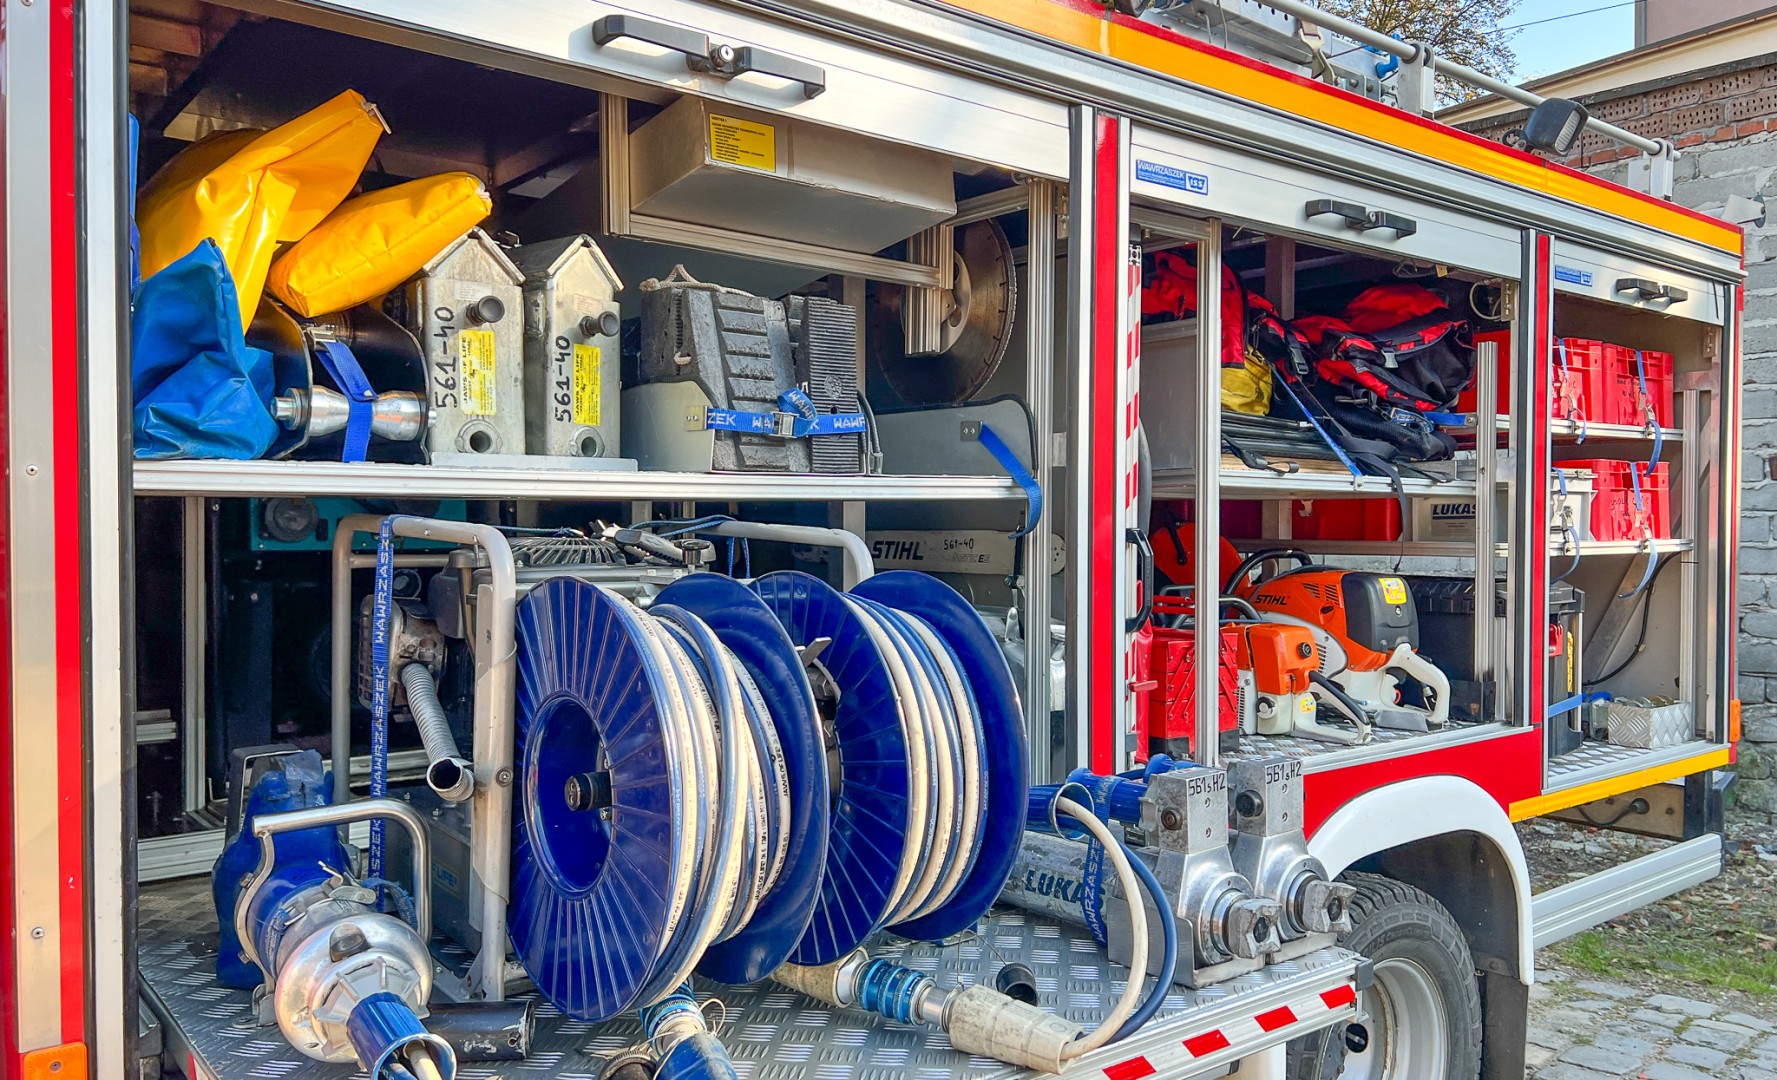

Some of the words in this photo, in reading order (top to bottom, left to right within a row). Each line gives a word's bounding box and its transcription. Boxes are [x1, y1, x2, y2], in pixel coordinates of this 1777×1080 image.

[1137, 160, 1186, 179] WAWRZASZEK
[434, 306, 457, 408] 561-40
[554, 335, 572, 423] 561-40
[872, 541, 924, 560] STIHL
[944, 538, 974, 550] 561-40
[1255, 594, 1288, 606] STIHL
[372, 665, 386, 797] WAWRZASZEK
[781, 773, 789, 797] JAWS
[1084, 838, 1106, 943] WAWRZASZE
